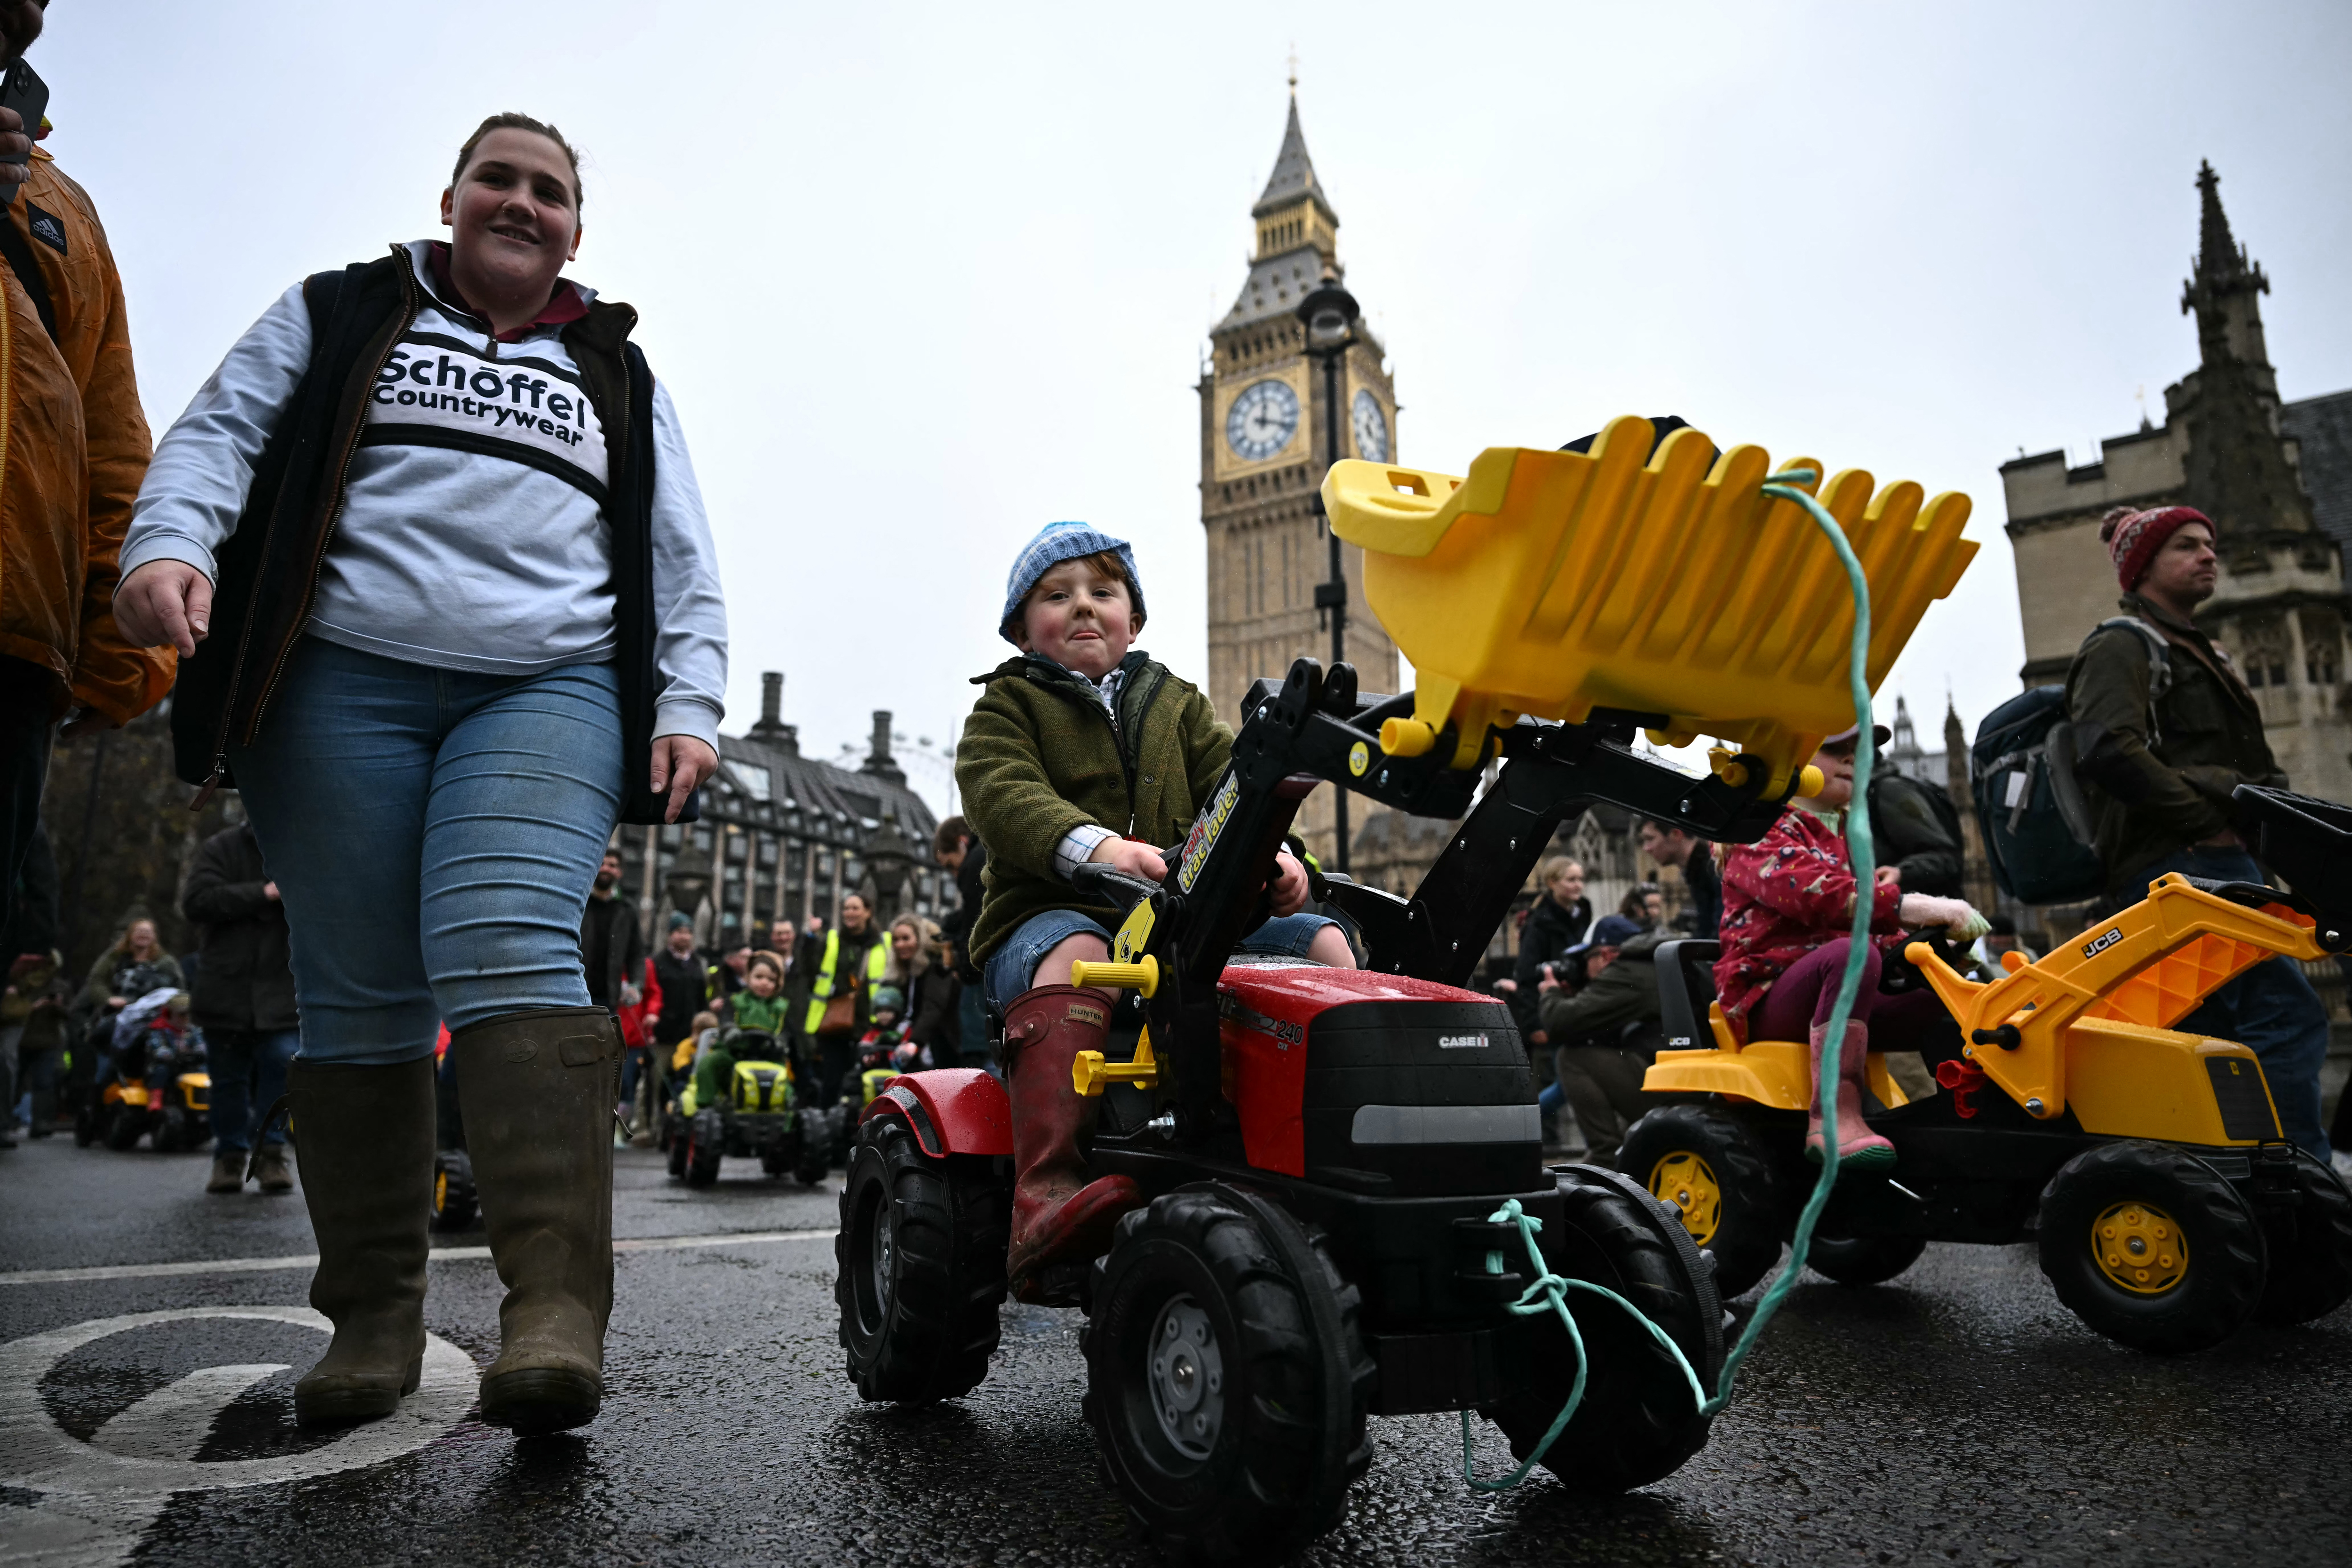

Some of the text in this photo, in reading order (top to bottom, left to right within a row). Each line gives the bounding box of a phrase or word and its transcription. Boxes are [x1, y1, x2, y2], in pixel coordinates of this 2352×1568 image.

[33, 224, 64, 246] adidas
[373, 385, 583, 446] Countrywear
[1183, 820, 1204, 863] rolly
[2086, 928, 2122, 957] JCB
[1071, 1008, 1102, 1021] HUNTER
[1276, 1019, 1303, 1045] 240
[1669, 1037, 1690, 1046] JCB
[1277, 1042, 1288, 1051] CVX
